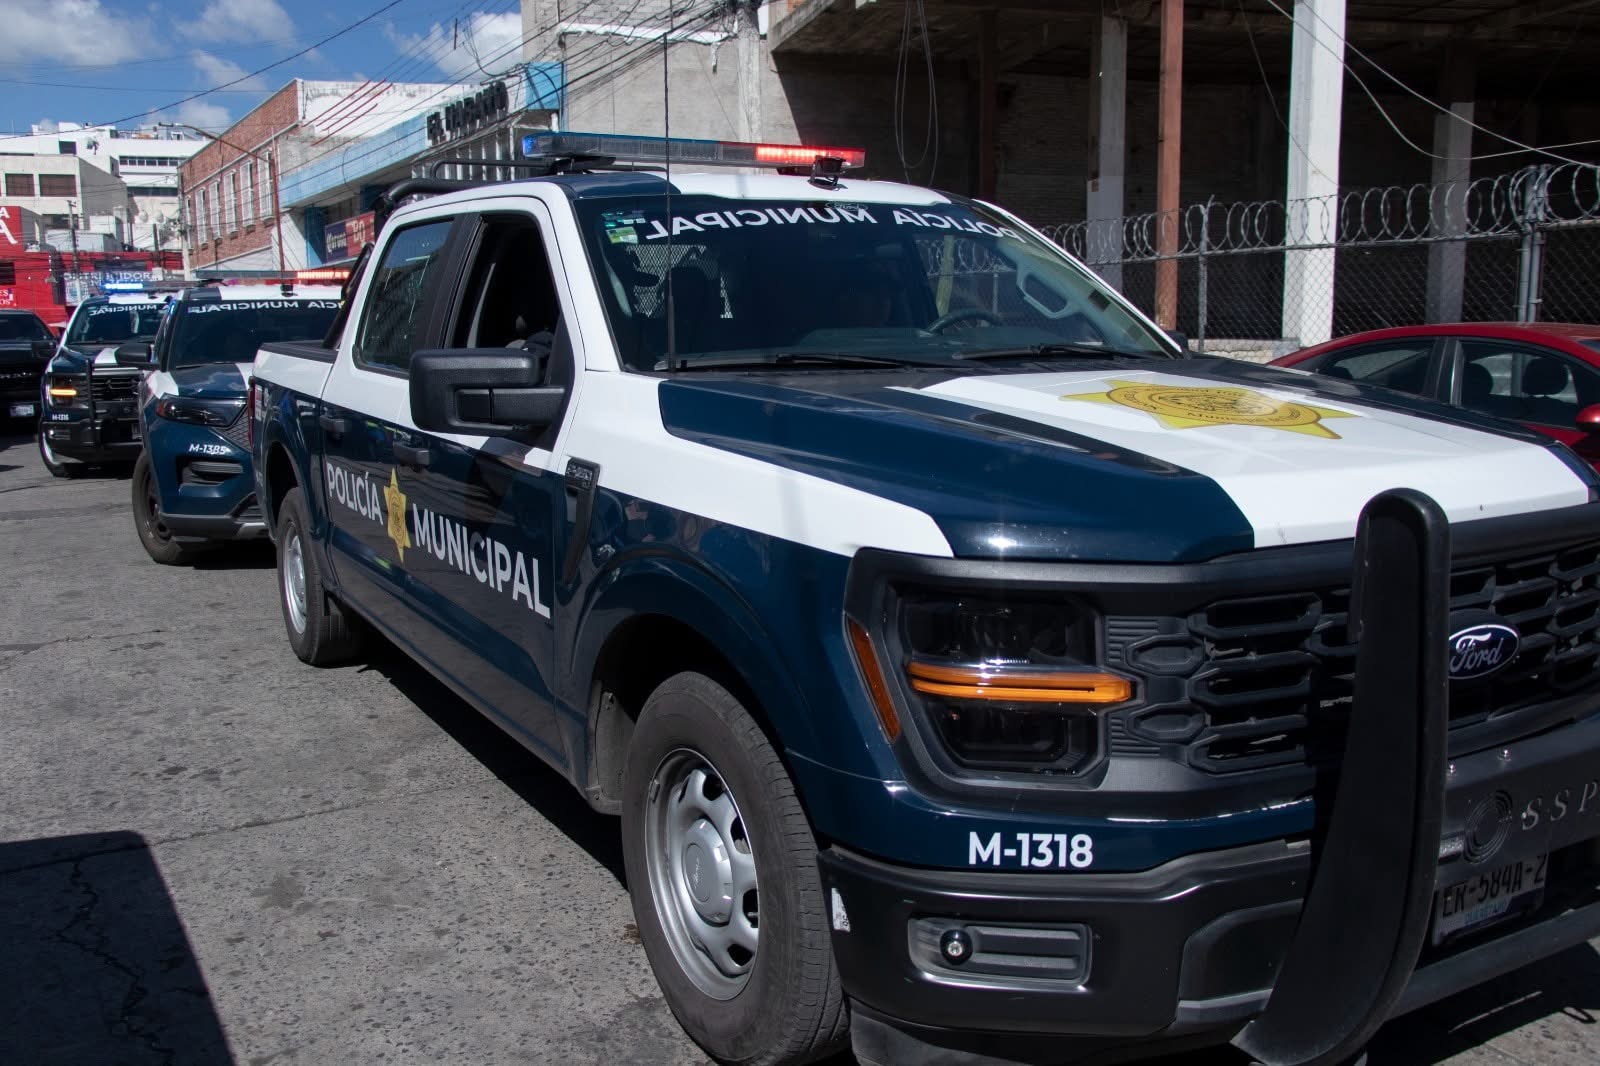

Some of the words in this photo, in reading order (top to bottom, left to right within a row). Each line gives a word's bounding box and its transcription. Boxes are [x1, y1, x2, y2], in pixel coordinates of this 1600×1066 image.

[327, 462, 384, 526] POLICÍA
[412, 503, 551, 620] MUNICIPAL
[1450, 631, 1502, 673] Ford
[967, 831, 1094, 869] M-1318
